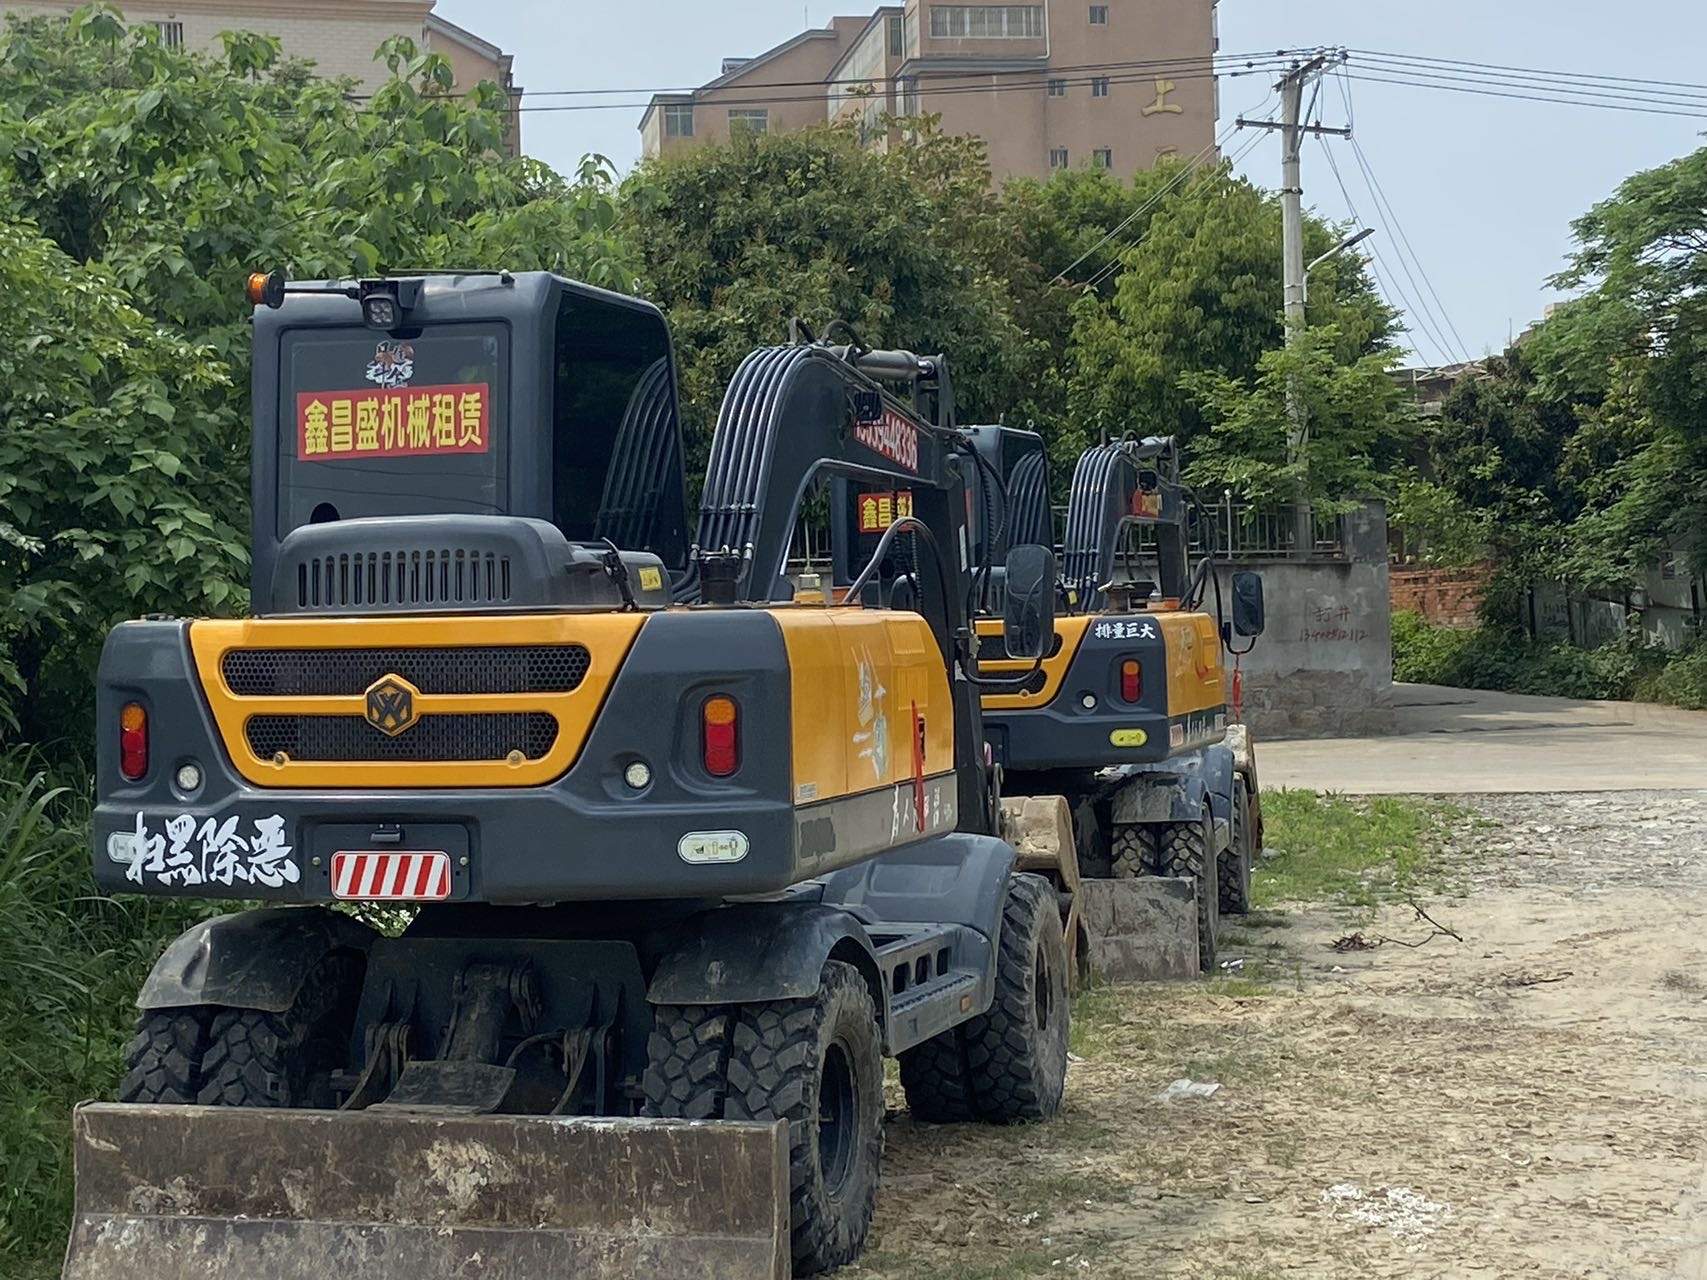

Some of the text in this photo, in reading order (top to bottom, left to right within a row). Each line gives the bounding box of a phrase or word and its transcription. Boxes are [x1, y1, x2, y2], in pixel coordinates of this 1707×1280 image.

[304, 392, 483, 455] 鑫昌盛机械租赁
[1095, 622, 1156, 639] 排量巨大
[126, 811, 301, 888] 扫黑除恶
